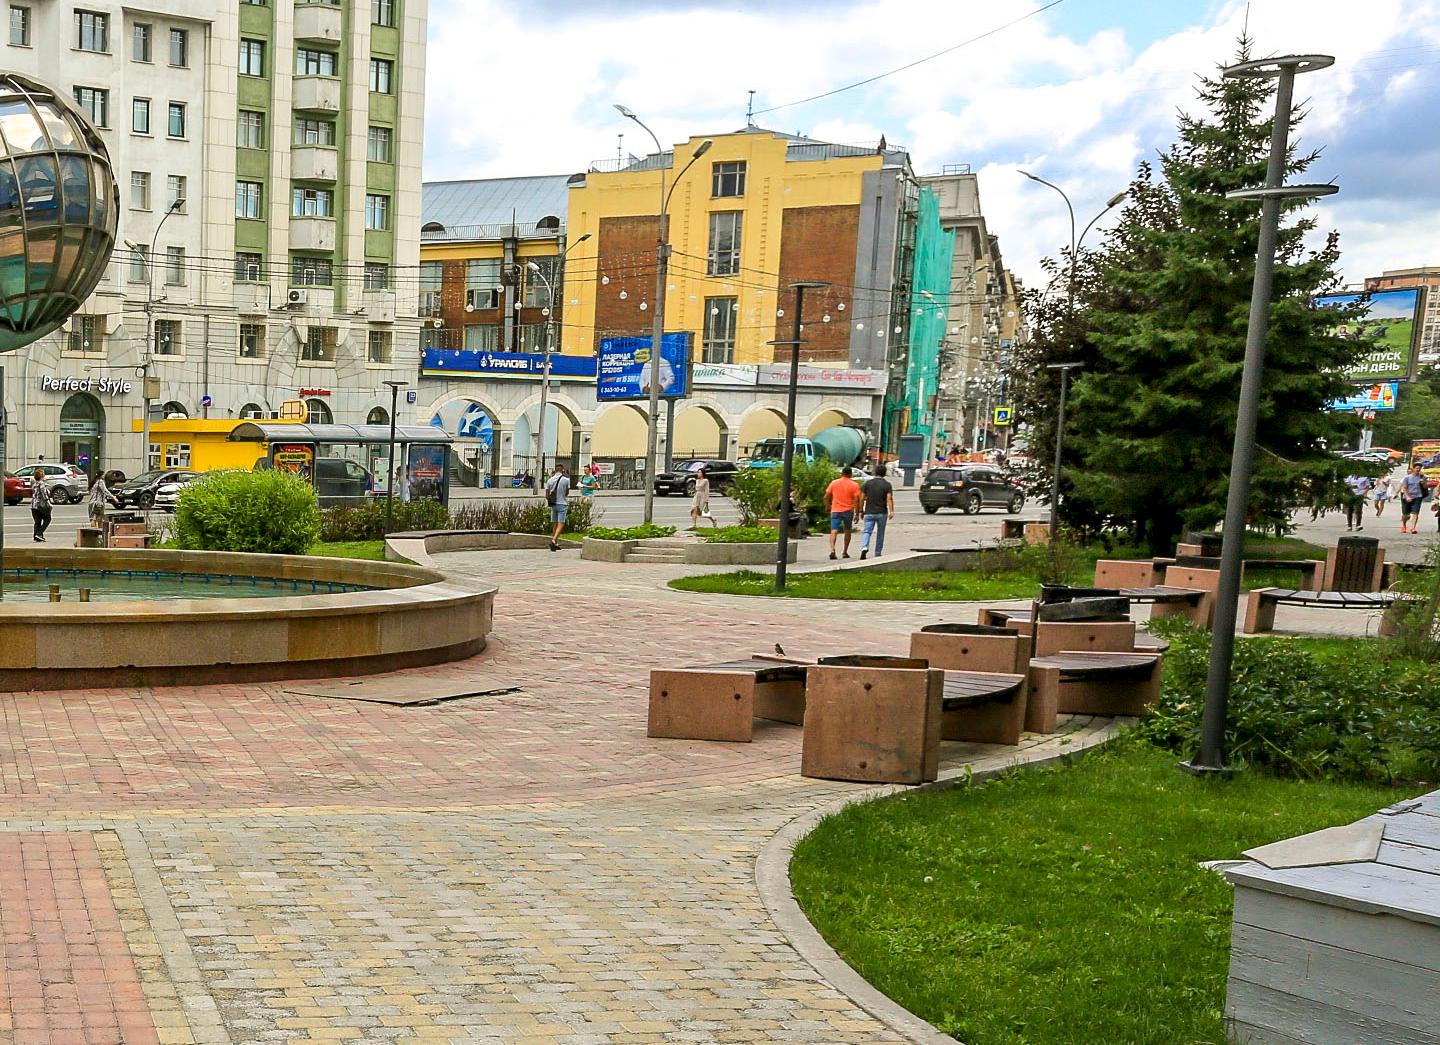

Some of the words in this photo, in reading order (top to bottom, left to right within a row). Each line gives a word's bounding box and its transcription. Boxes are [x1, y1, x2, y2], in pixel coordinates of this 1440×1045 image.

[488, 357, 528, 369] УРАЛСИБ
[1369, 362, 1400, 373] ДЕНЬ
[42, 375, 92, 391] Perfect
[98, 377, 132, 397] Style
